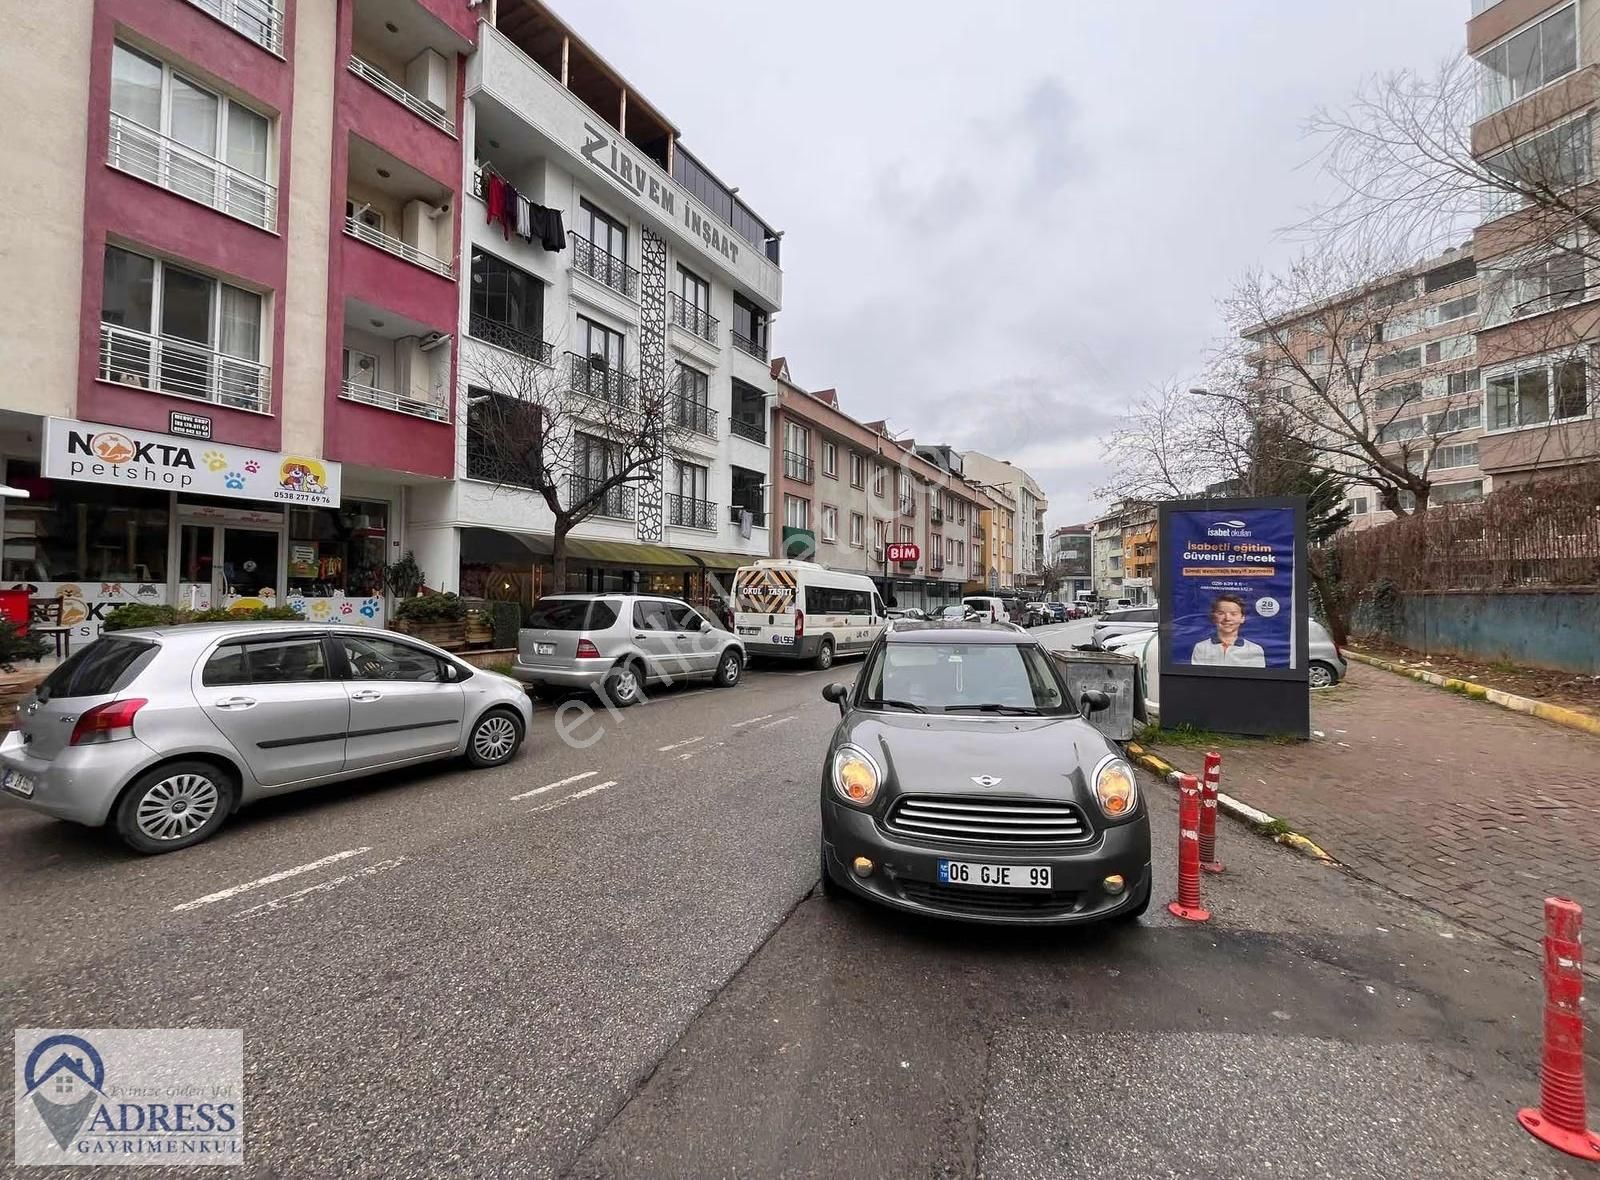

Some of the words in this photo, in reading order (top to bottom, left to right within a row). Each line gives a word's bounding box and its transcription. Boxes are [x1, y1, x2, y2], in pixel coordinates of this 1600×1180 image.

[580, 122, 675, 216] ZİRVEM
[684, 201, 739, 264] İNŞAAT
[71, 461, 192, 488] petshop
[274, 491, 293, 499] 0538
[890, 545, 916, 559] BİM
[1233, 543, 1272, 553] eğitim
[1183, 552, 1225, 560] Güvenli
[1228, 554, 1276, 563] gelecek
[742, 587, 762, 595] OKUL
[950, 863, 969, 882] 06
[981, 866, 1010, 885] GJE
[1030, 867, 1049, 886] 99
